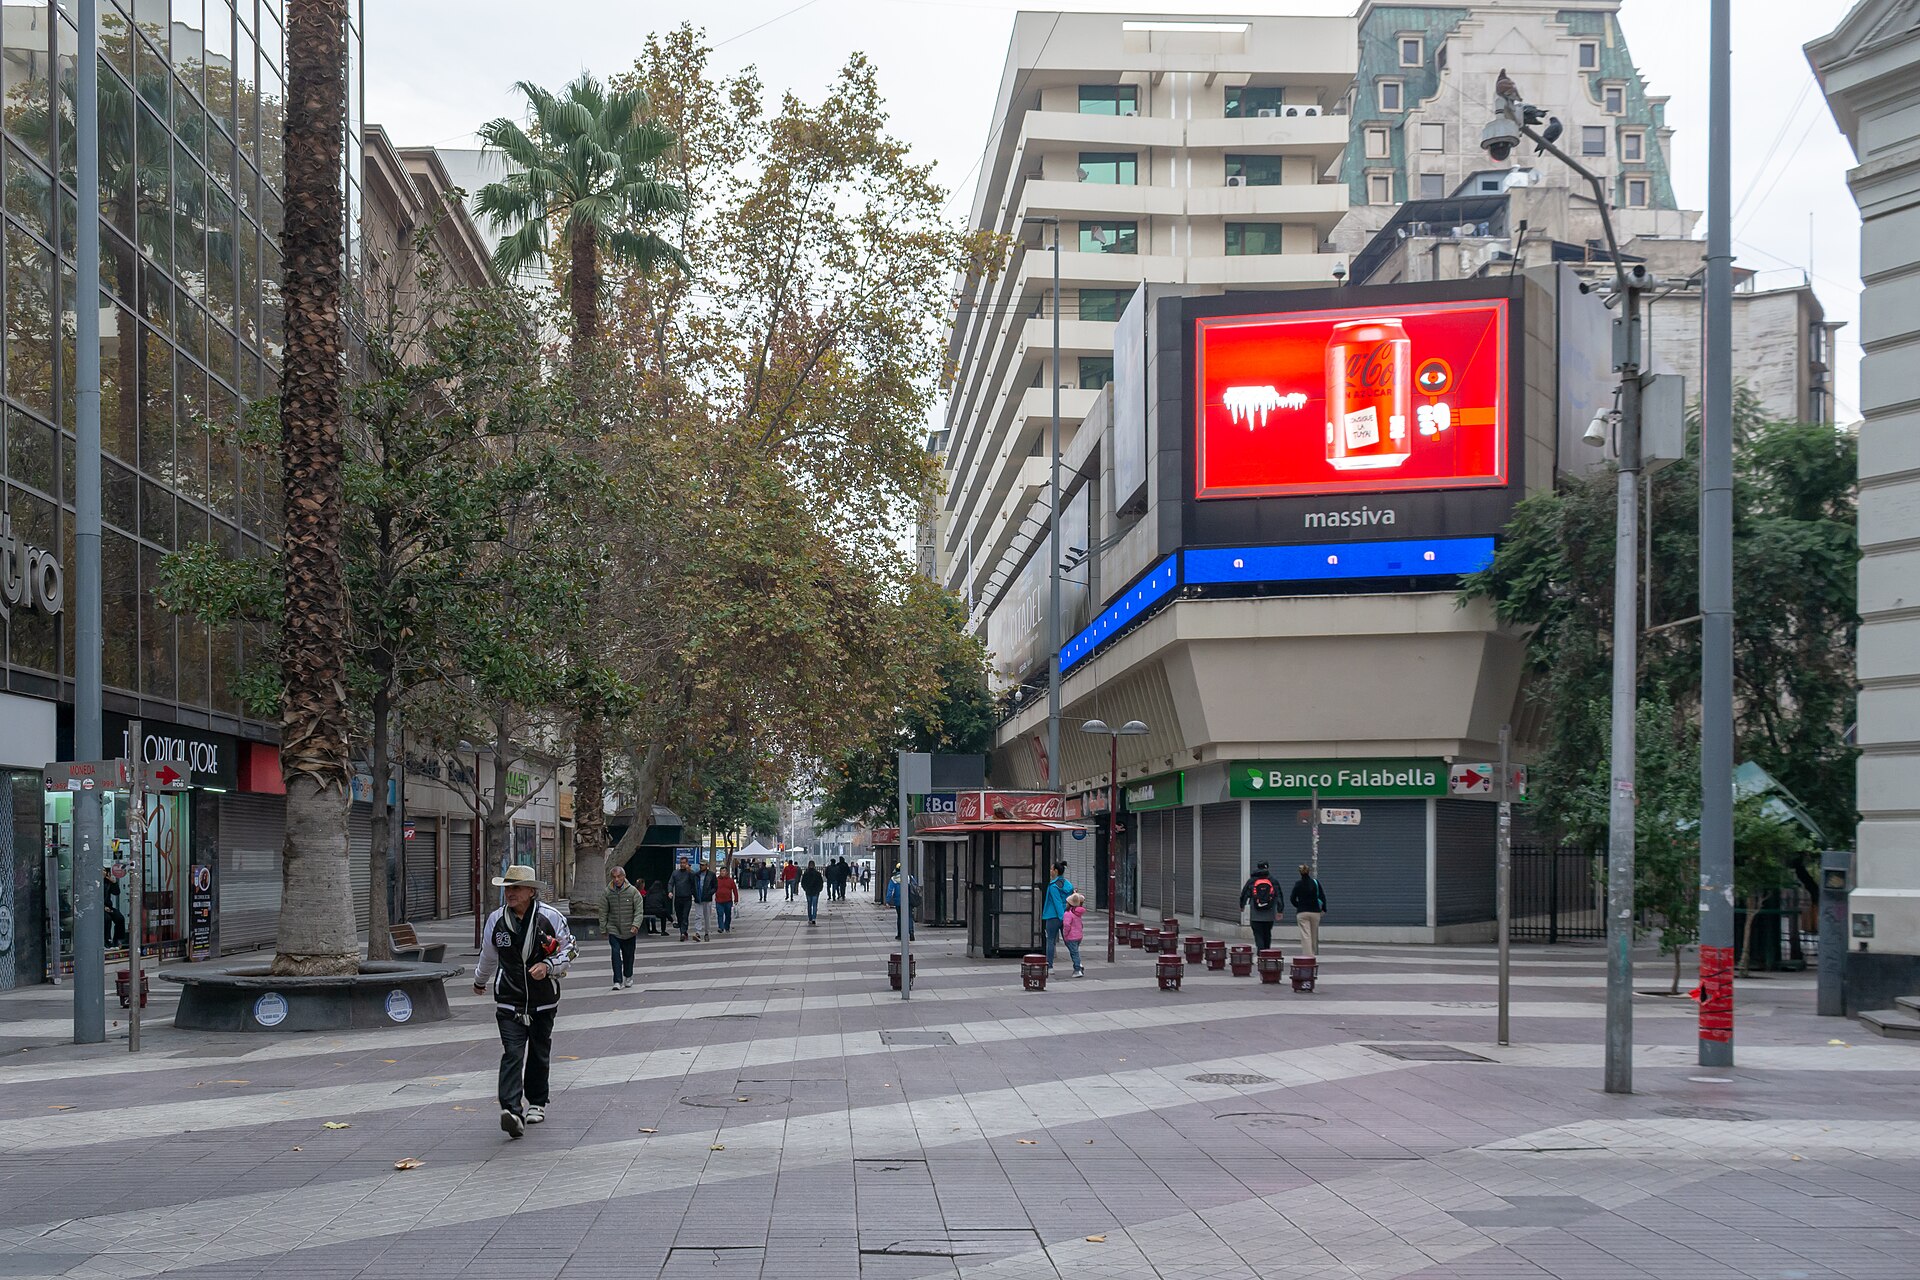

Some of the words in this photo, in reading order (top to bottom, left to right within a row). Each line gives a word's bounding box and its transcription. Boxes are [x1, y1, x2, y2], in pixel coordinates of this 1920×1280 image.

[1304, 505, 1396, 528] massiva
[144, 735, 186, 764] OPTICAL
[189, 740, 219, 774] STORE
[69, 764, 96, 777] MONEDA
[1269, 770, 1332, 788] Banco
[1338, 768, 1436, 787] Falabella
[932, 797, 956, 812] Ba
[1028, 979, 1040, 987] 33
[1166, 979, 1177, 987] 34
